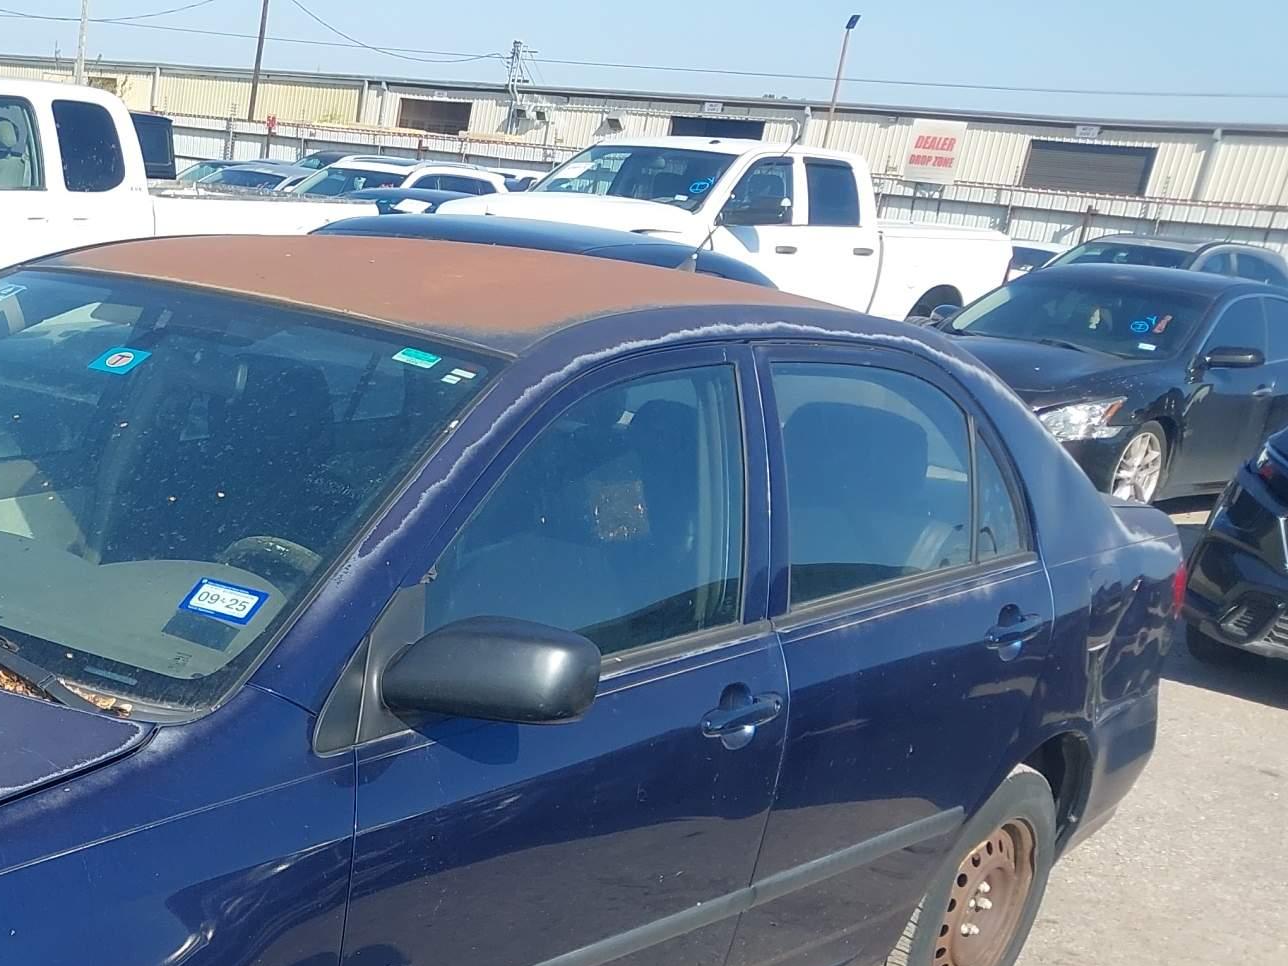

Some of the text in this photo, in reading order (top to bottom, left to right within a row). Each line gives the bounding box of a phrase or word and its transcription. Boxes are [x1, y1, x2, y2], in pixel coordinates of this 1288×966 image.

[914, 135, 957, 152] DEALER
[908, 154, 955, 168] DROP ZONE
